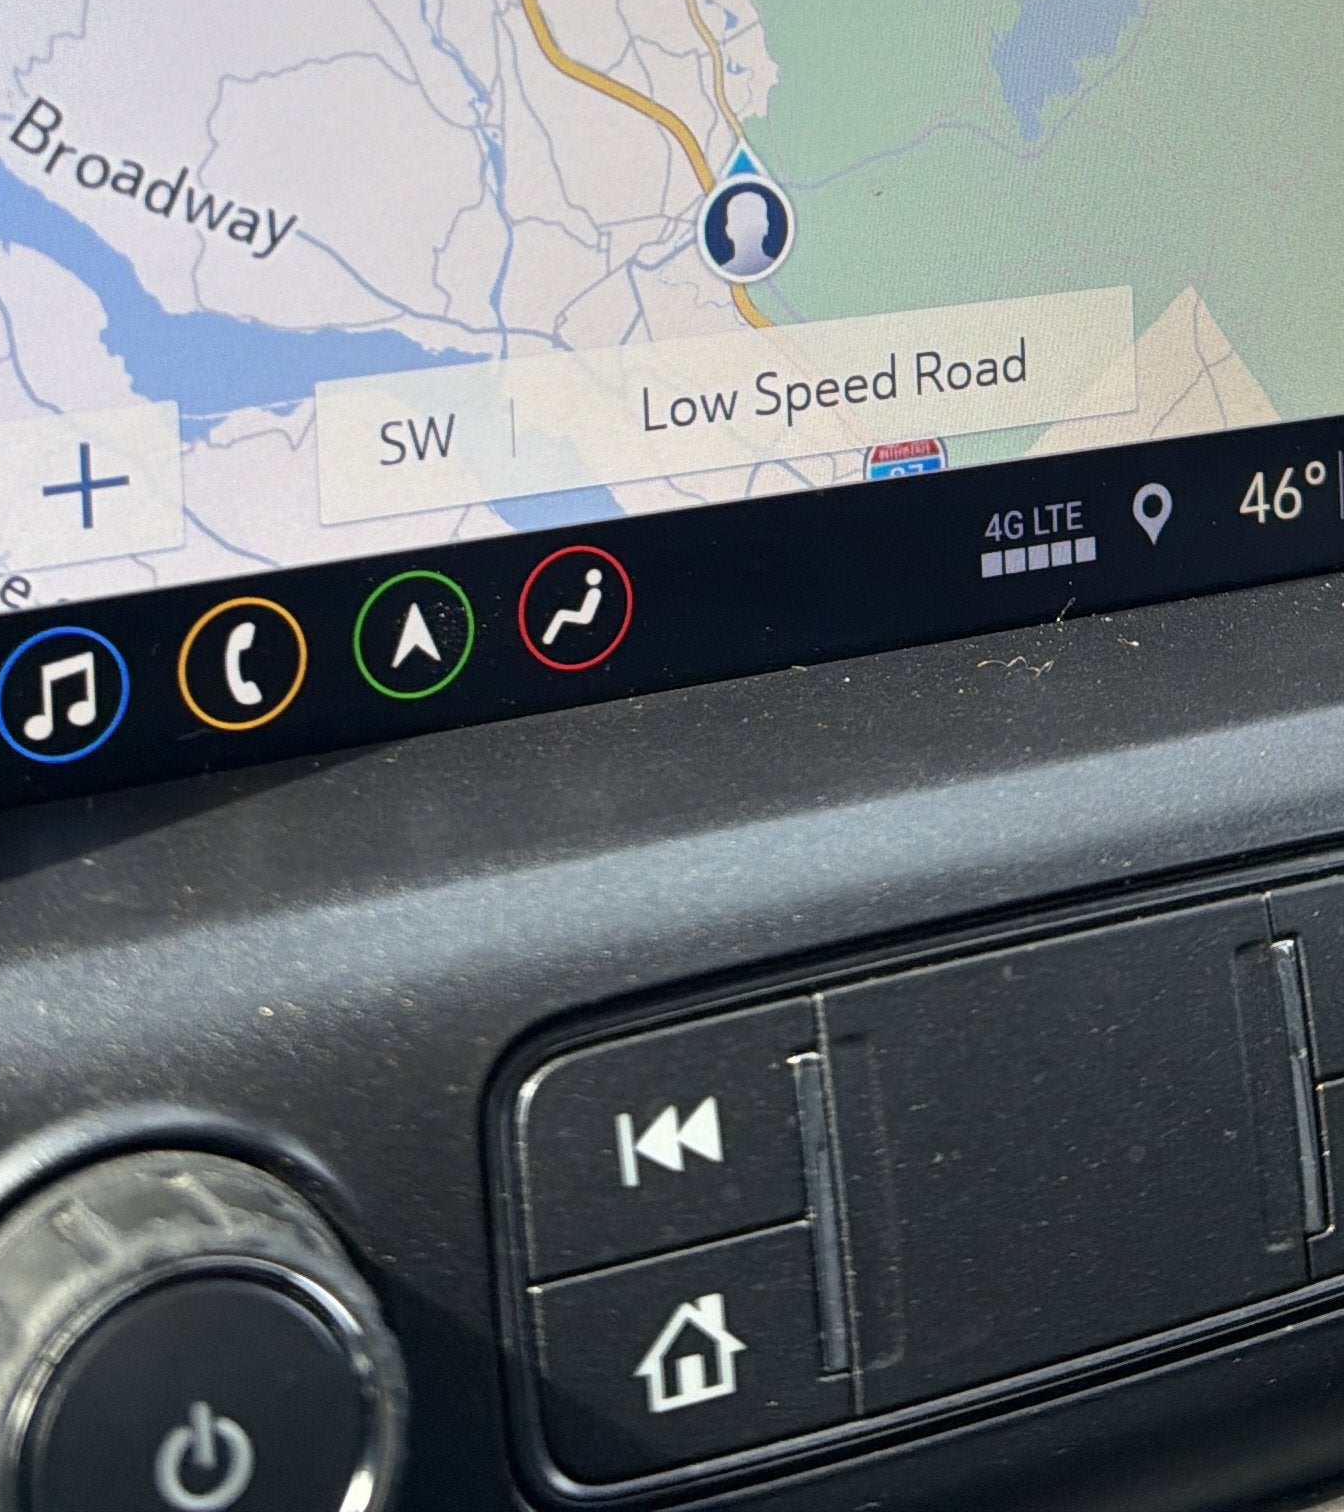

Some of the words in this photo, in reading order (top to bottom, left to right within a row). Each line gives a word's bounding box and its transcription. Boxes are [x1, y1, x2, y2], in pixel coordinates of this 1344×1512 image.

[9, 96, 298, 259] Broadway
[643, 386, 738, 431] Low
[755, 353, 897, 427] Speed
[916, 337, 1027, 396] Road
[380, 413, 455, 465] SW
[984, 510, 1024, 542] 4G
[1032, 501, 1084, 536] LTE
